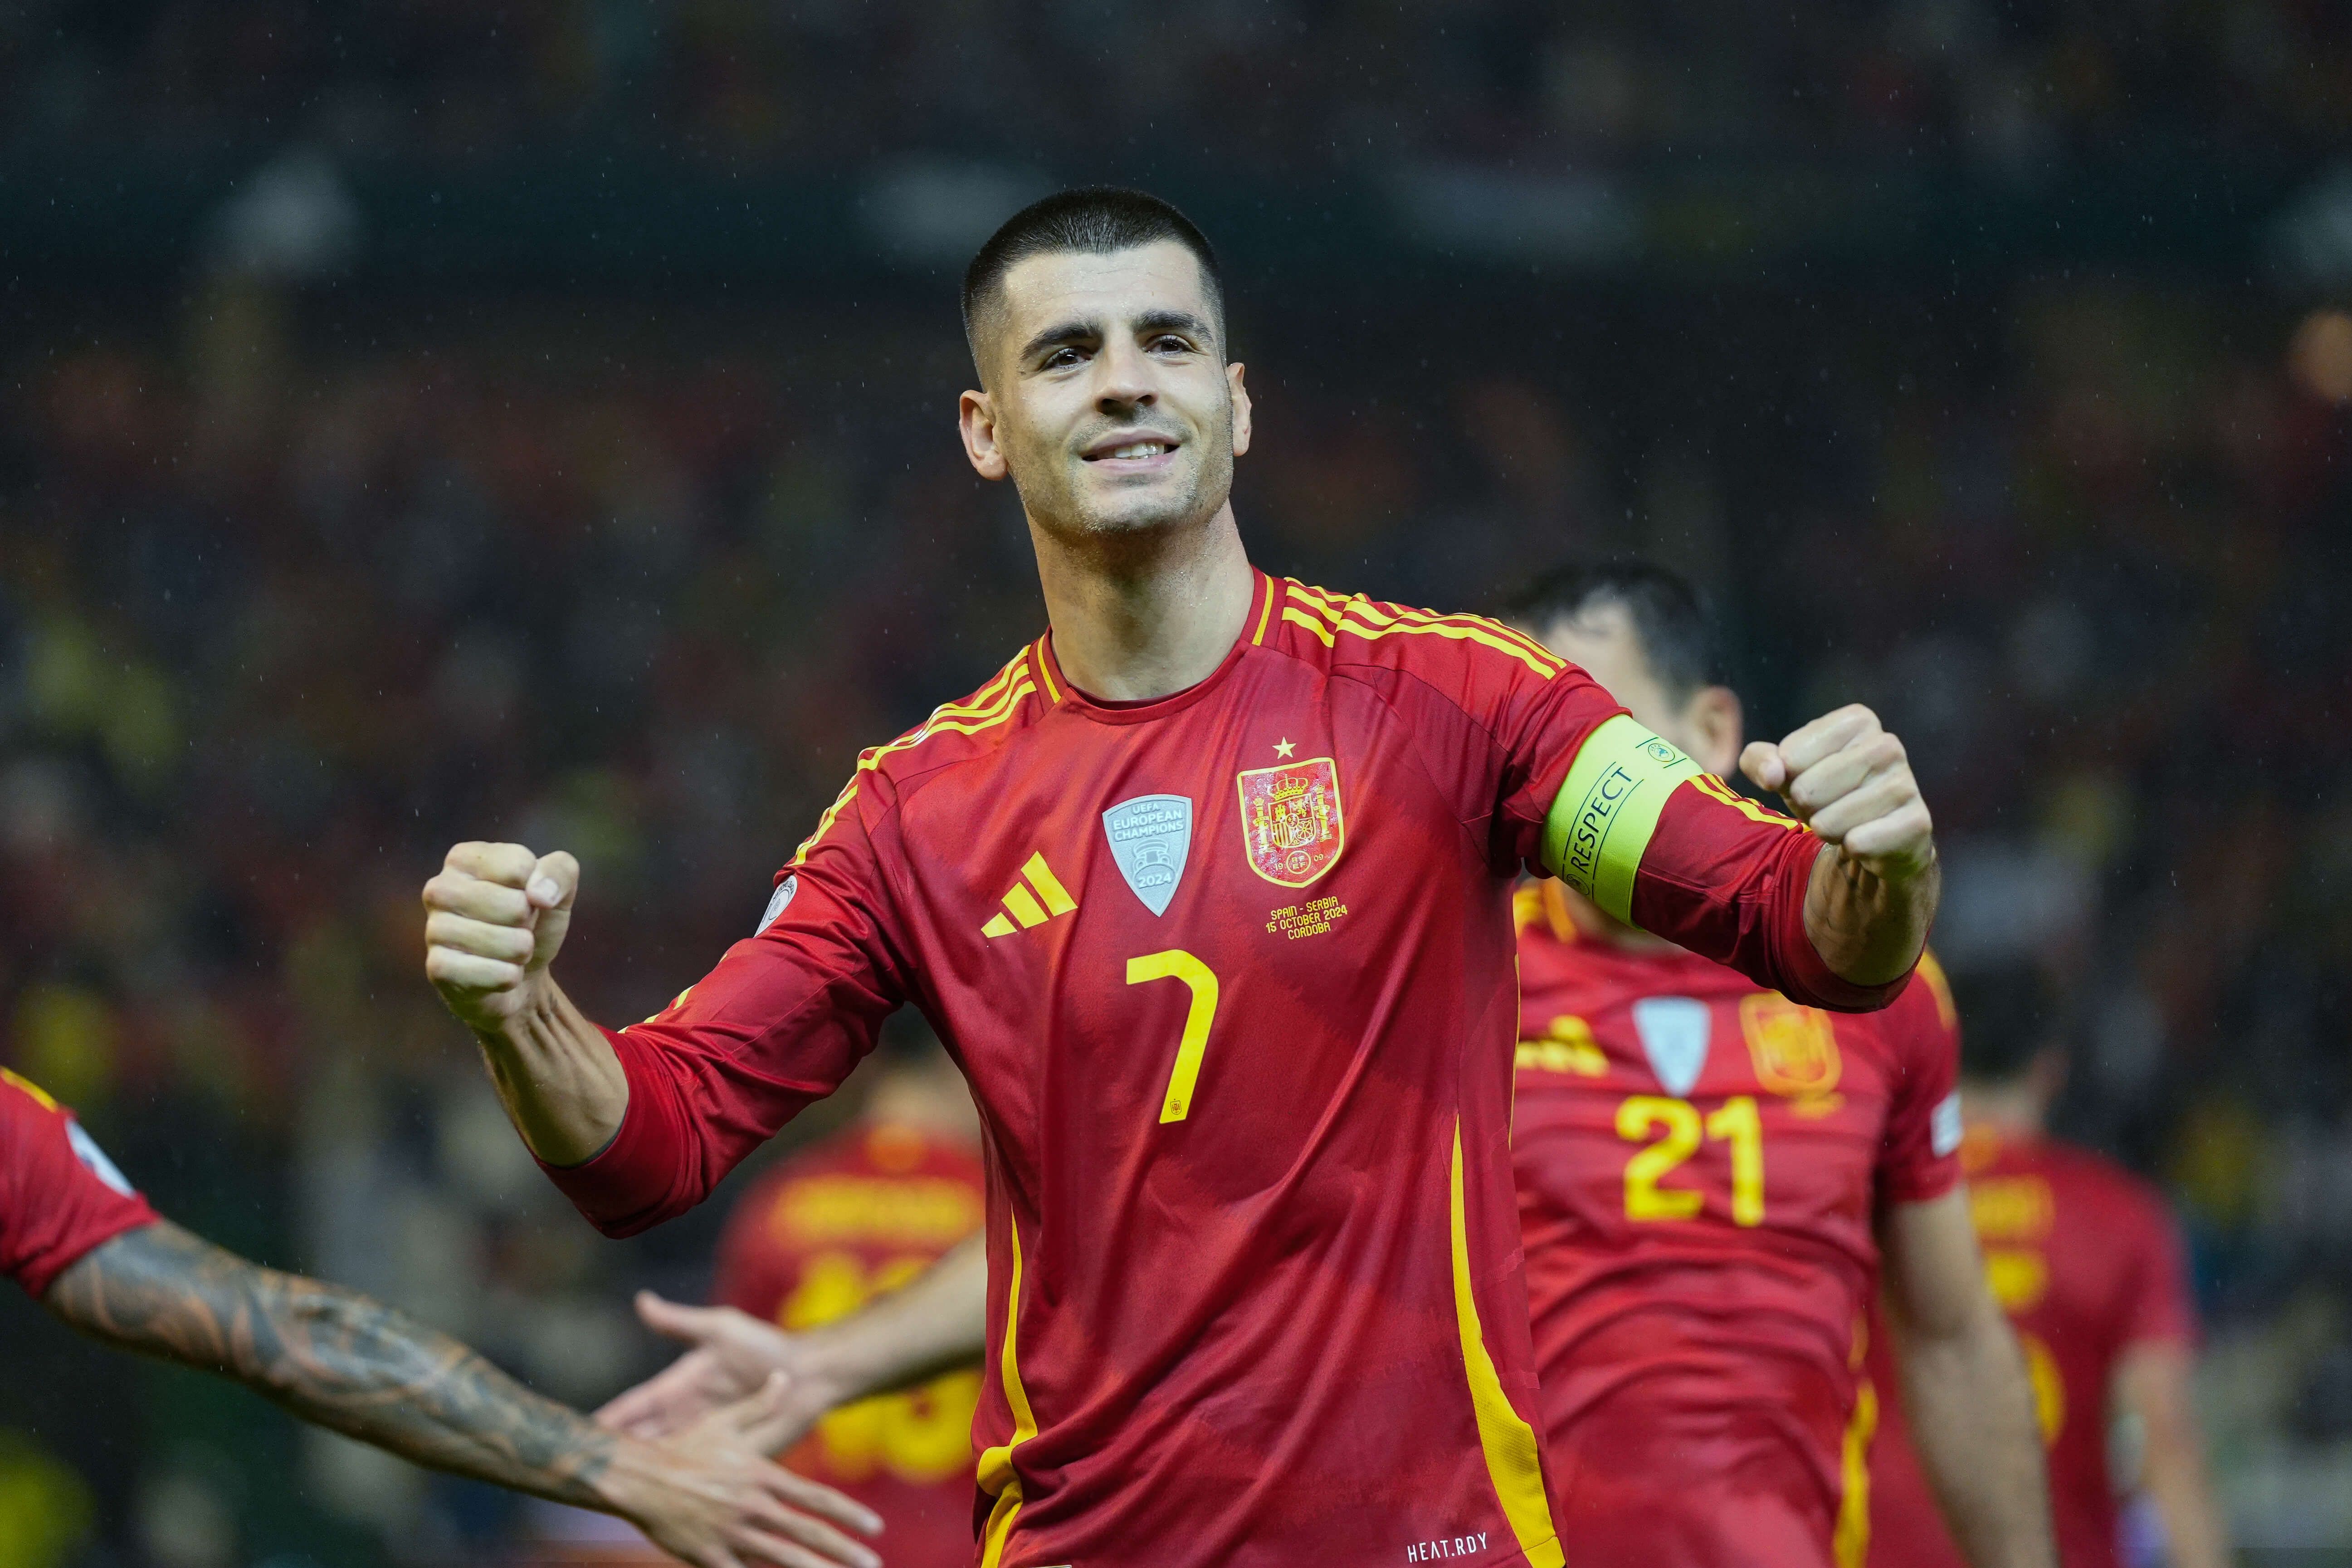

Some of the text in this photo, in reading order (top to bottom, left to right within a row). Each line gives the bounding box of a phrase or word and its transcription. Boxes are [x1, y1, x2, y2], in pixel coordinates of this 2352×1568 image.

[1113, 810, 1182, 830] EUROPEAN
[1132, 803, 1159, 814] UEFA
[1571, 767, 1632, 874] RESPECT
[1114, 821, 1184, 840] CHAMPIONS
[1138, 873, 1171, 889] 2024
[1265, 904, 1348, 933] 15 OCTOBER 2024
[1270, 905, 1298, 920] SPAIN
[1306, 896, 1339, 913] SERBIA
[1287, 921, 1331, 940] CORDOBA
[1126, 949, 1219, 1124] 7
[1615, 1094, 1766, 1226] 21
[1407, 1532, 1487, 1563] HEAT.RDY
